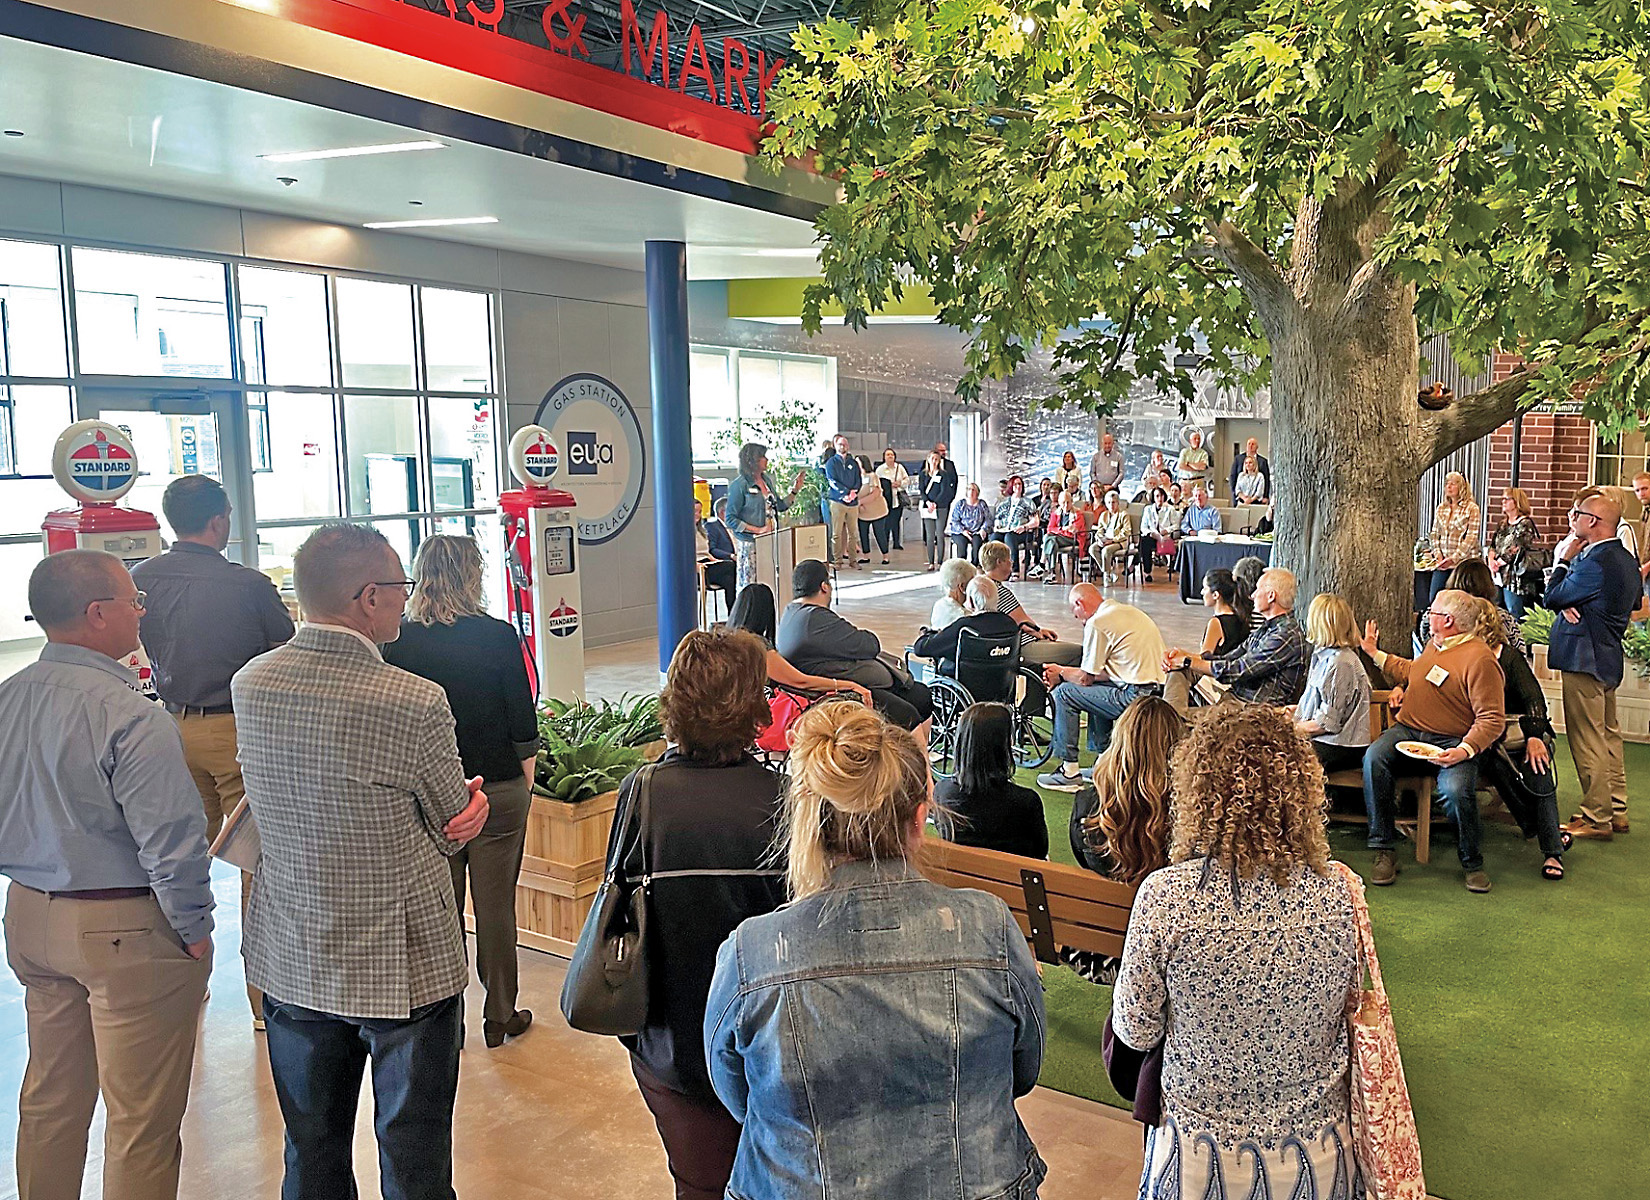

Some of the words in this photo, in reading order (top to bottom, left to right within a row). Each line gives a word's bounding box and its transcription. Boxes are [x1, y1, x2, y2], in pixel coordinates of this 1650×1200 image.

[553, 387, 576, 411] GAS
[579, 384, 626, 417] STATION
[526, 456, 558, 465] STANDARD
[74, 462, 131, 472] STANDARD
[549, 616, 578, 627] STANDARD
